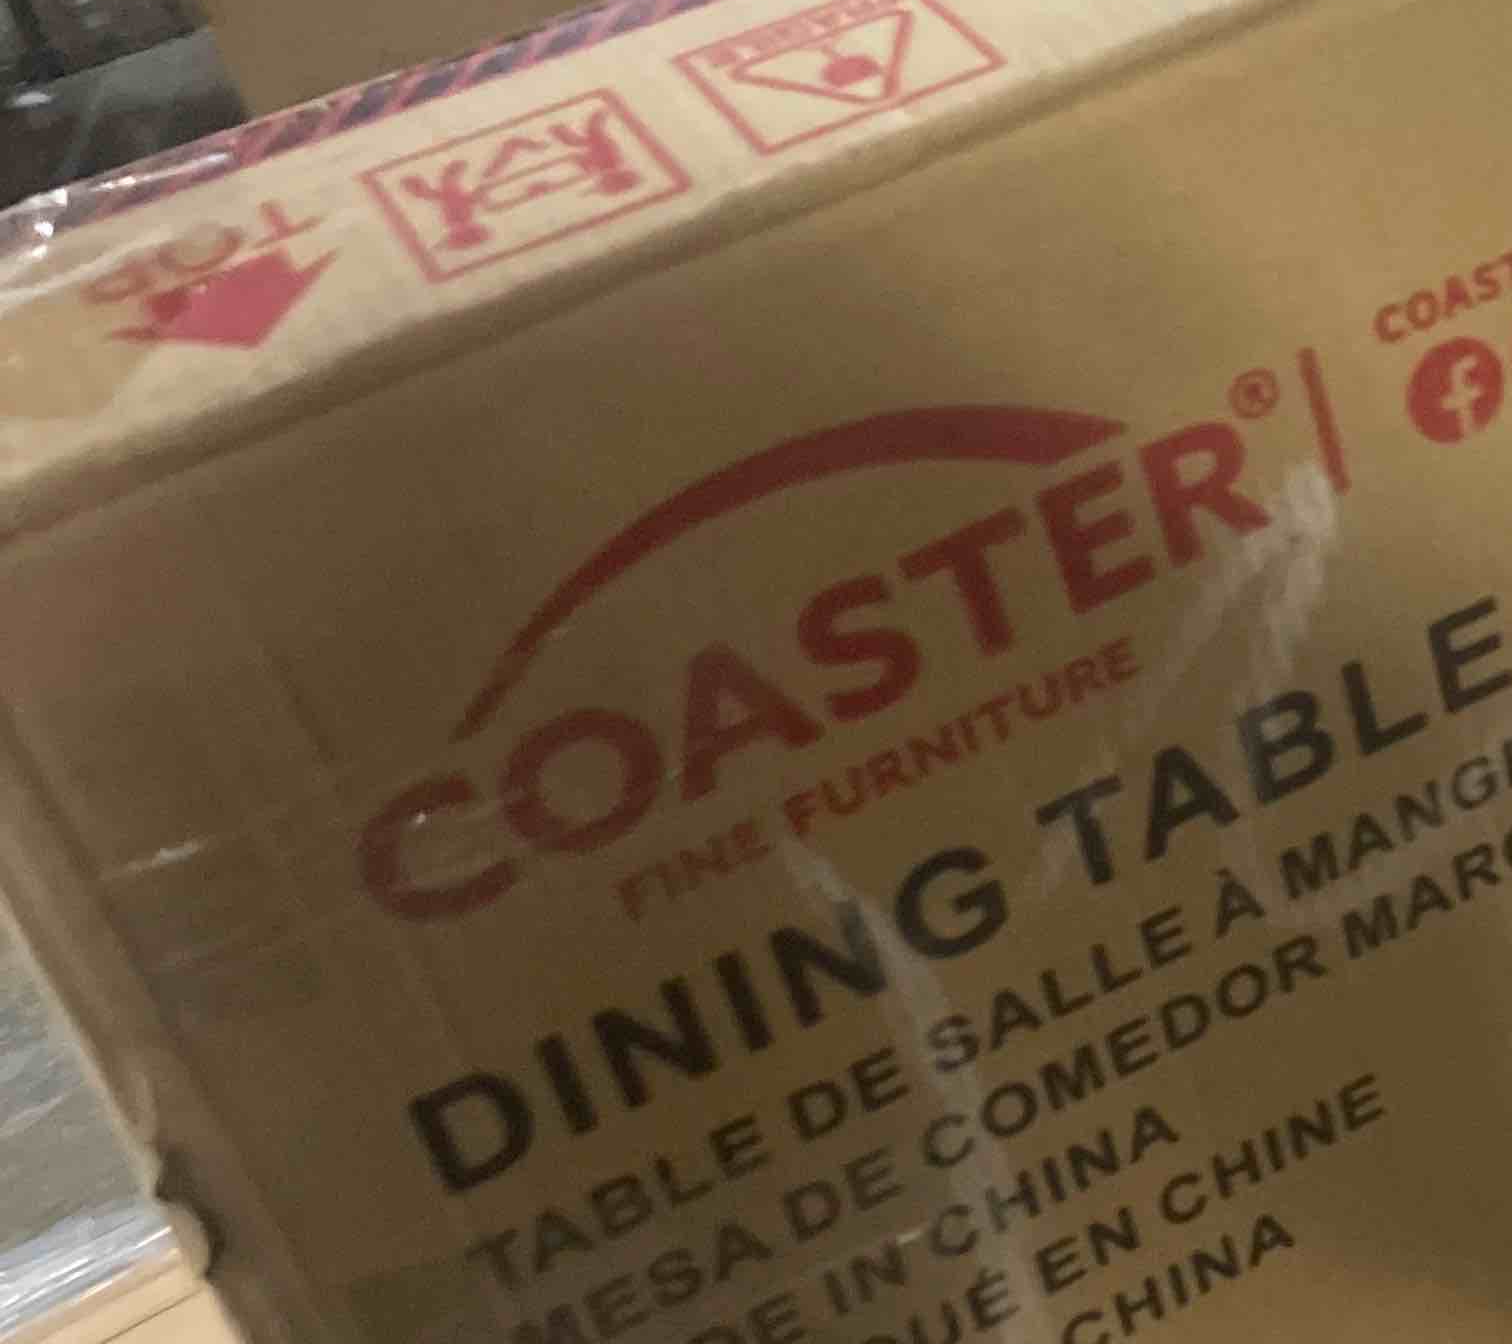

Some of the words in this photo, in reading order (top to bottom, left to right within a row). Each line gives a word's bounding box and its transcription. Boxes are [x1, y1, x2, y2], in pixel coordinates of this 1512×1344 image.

[615, 816, 772, 921] FINE
[780, 634, 1143, 840] FURNITURE
[408, 844, 1012, 1196] DINING
[468, 1114, 774, 1294] TABLE
[788, 1045, 913, 1144] DE
[924, 905, 1194, 1076] SALLE
[782, 1148, 907, 1245] DE
[919, 934, 1329, 1173] COMEDOR
[825, 1240, 914, 1317] IN
[929, 1102, 1183, 1260] CHINA
[1036, 1203, 1142, 1297] EN
[1157, 1071, 1390, 1227] CHINE
